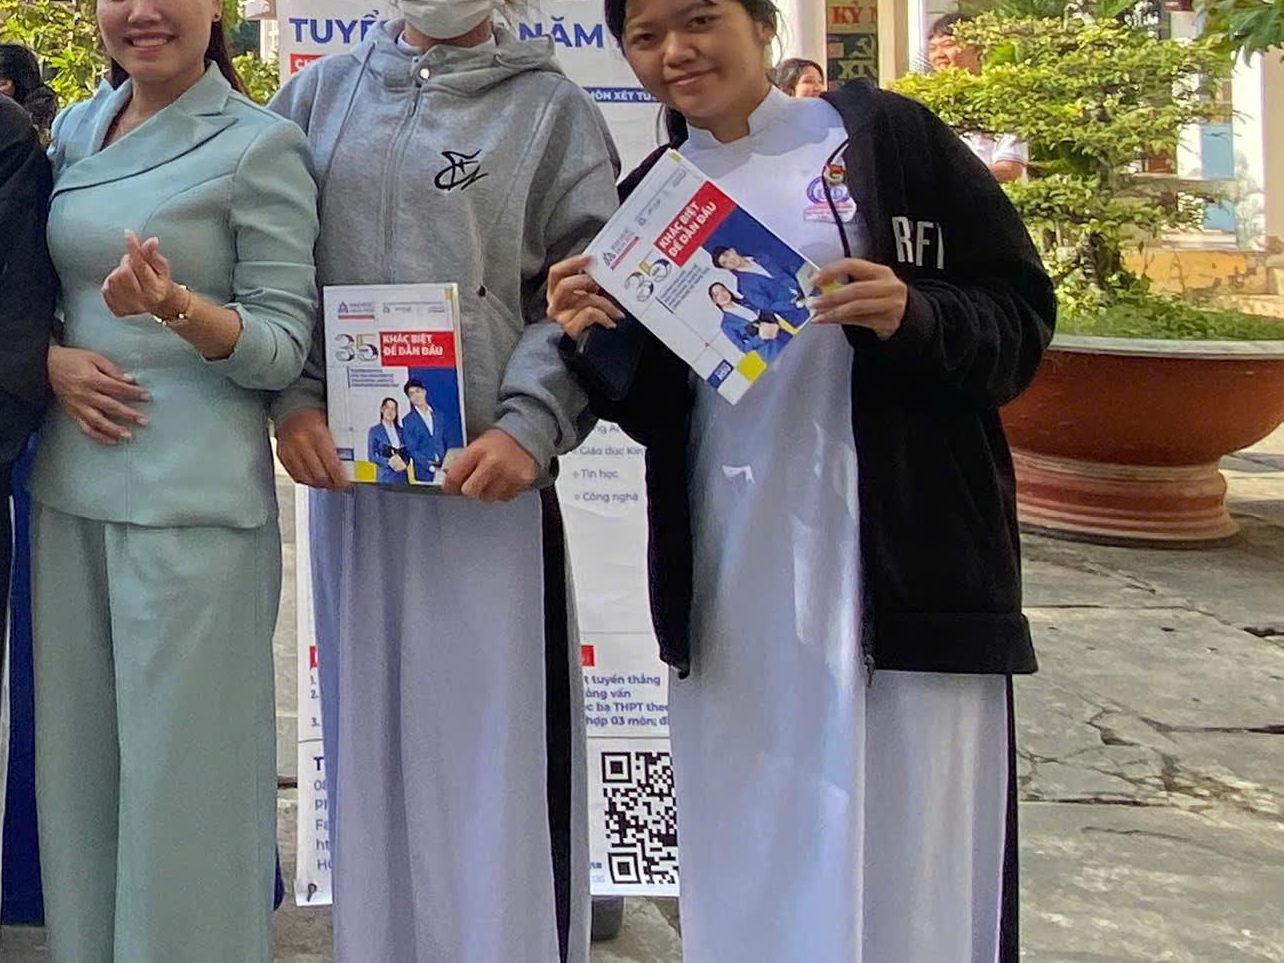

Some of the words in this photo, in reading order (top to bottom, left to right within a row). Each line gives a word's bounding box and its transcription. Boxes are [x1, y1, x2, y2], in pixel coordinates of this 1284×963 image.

[519, 15, 604, 48] NĂM
[614, 89, 634, 101] XÉT
[658, 221, 683, 249] KHÁC
[382, 332, 408, 344] KHÁC
[335, 333, 379, 361] 35
[581, 469, 596, 478] Tin
[599, 468, 618, 480] học
[582, 492, 610, 504] Công
[613, 702, 644, 712] THPT
[610, 716, 626, 726] 03
